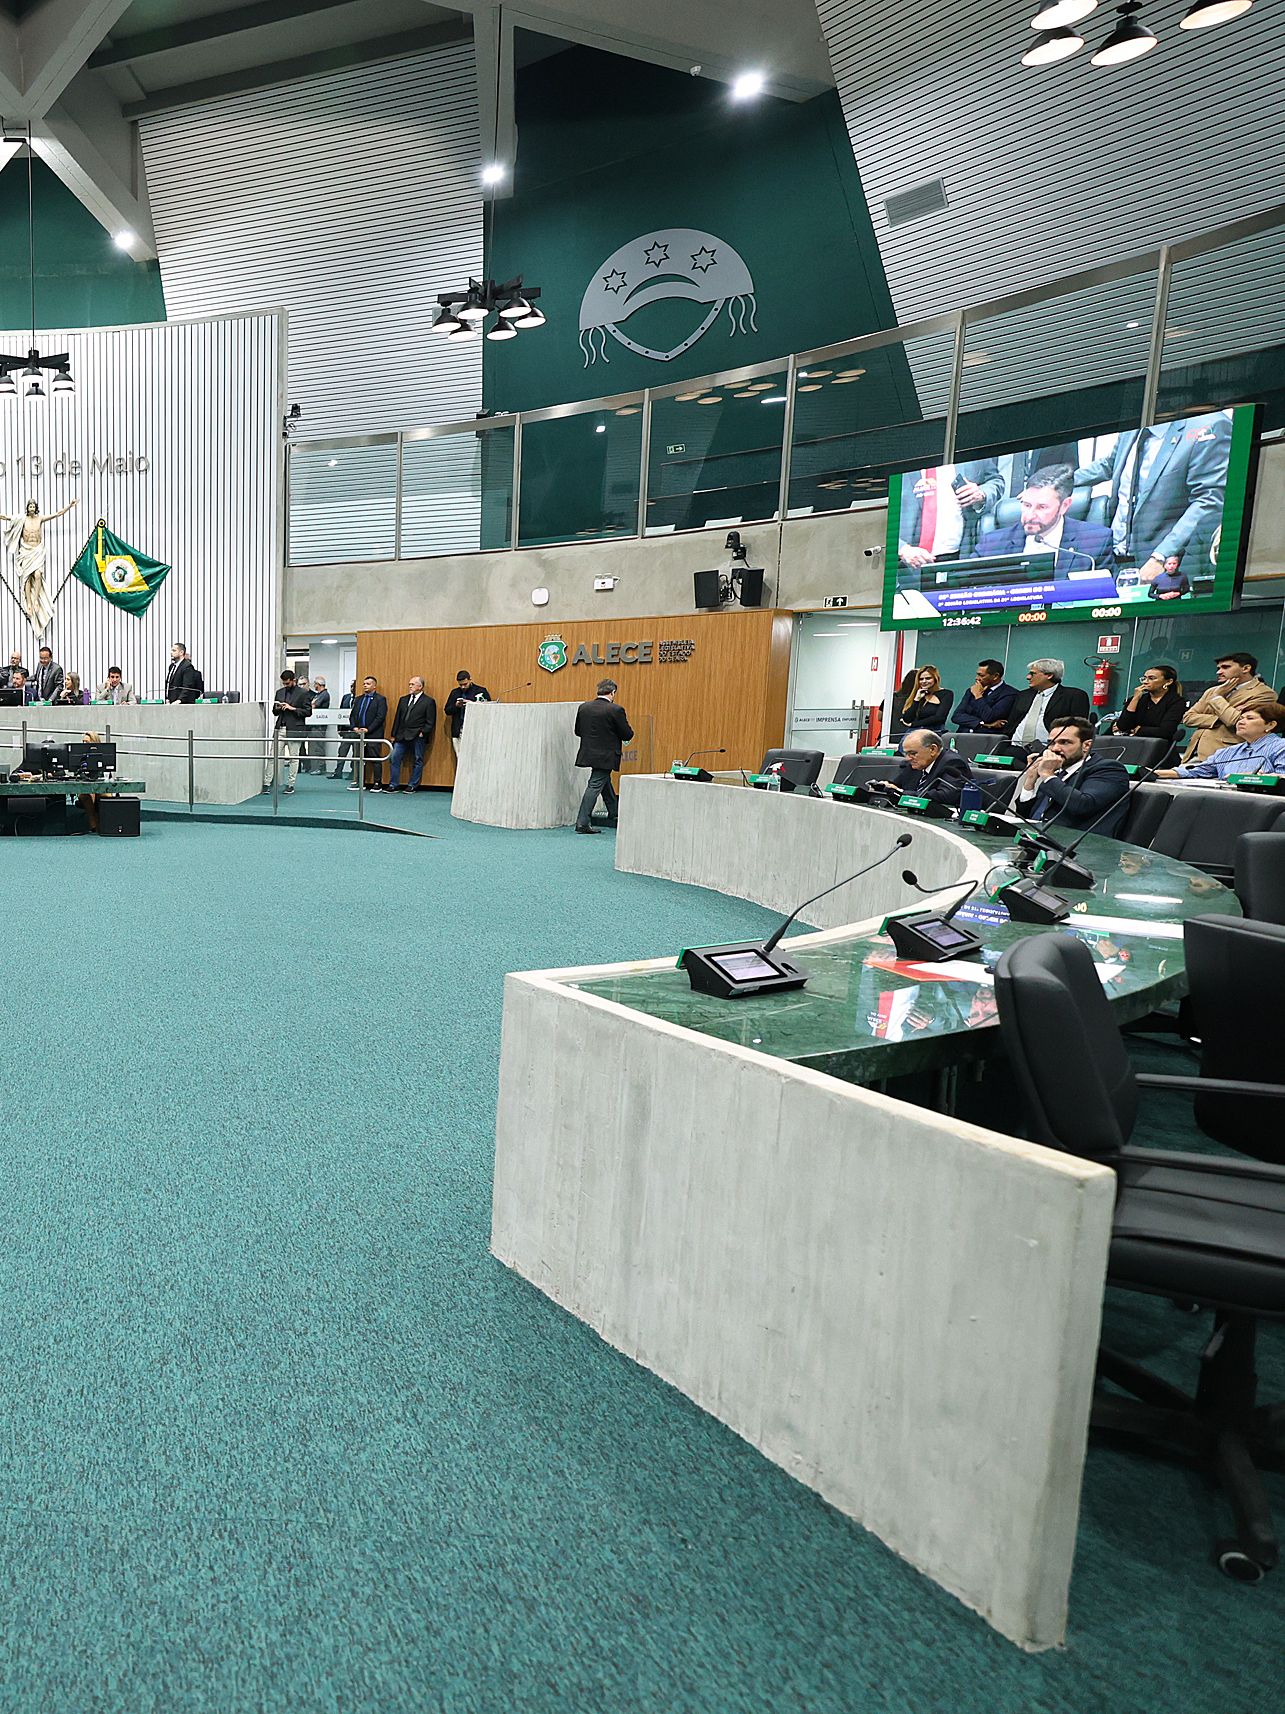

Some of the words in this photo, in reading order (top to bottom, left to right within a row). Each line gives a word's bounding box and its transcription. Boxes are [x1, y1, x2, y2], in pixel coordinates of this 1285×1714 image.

[15, 454, 44, 478] 13
[53, 452, 83, 477] de
[90, 449, 151, 477] Maio
[1018, 612, 1047, 622] 00:00
[1091, 607, 1122, 618] 00:00
[942, 616, 982, 627] 12:36:42
[572, 641, 654, 665] ALECE
[621, 750, 638, 762] LECE
